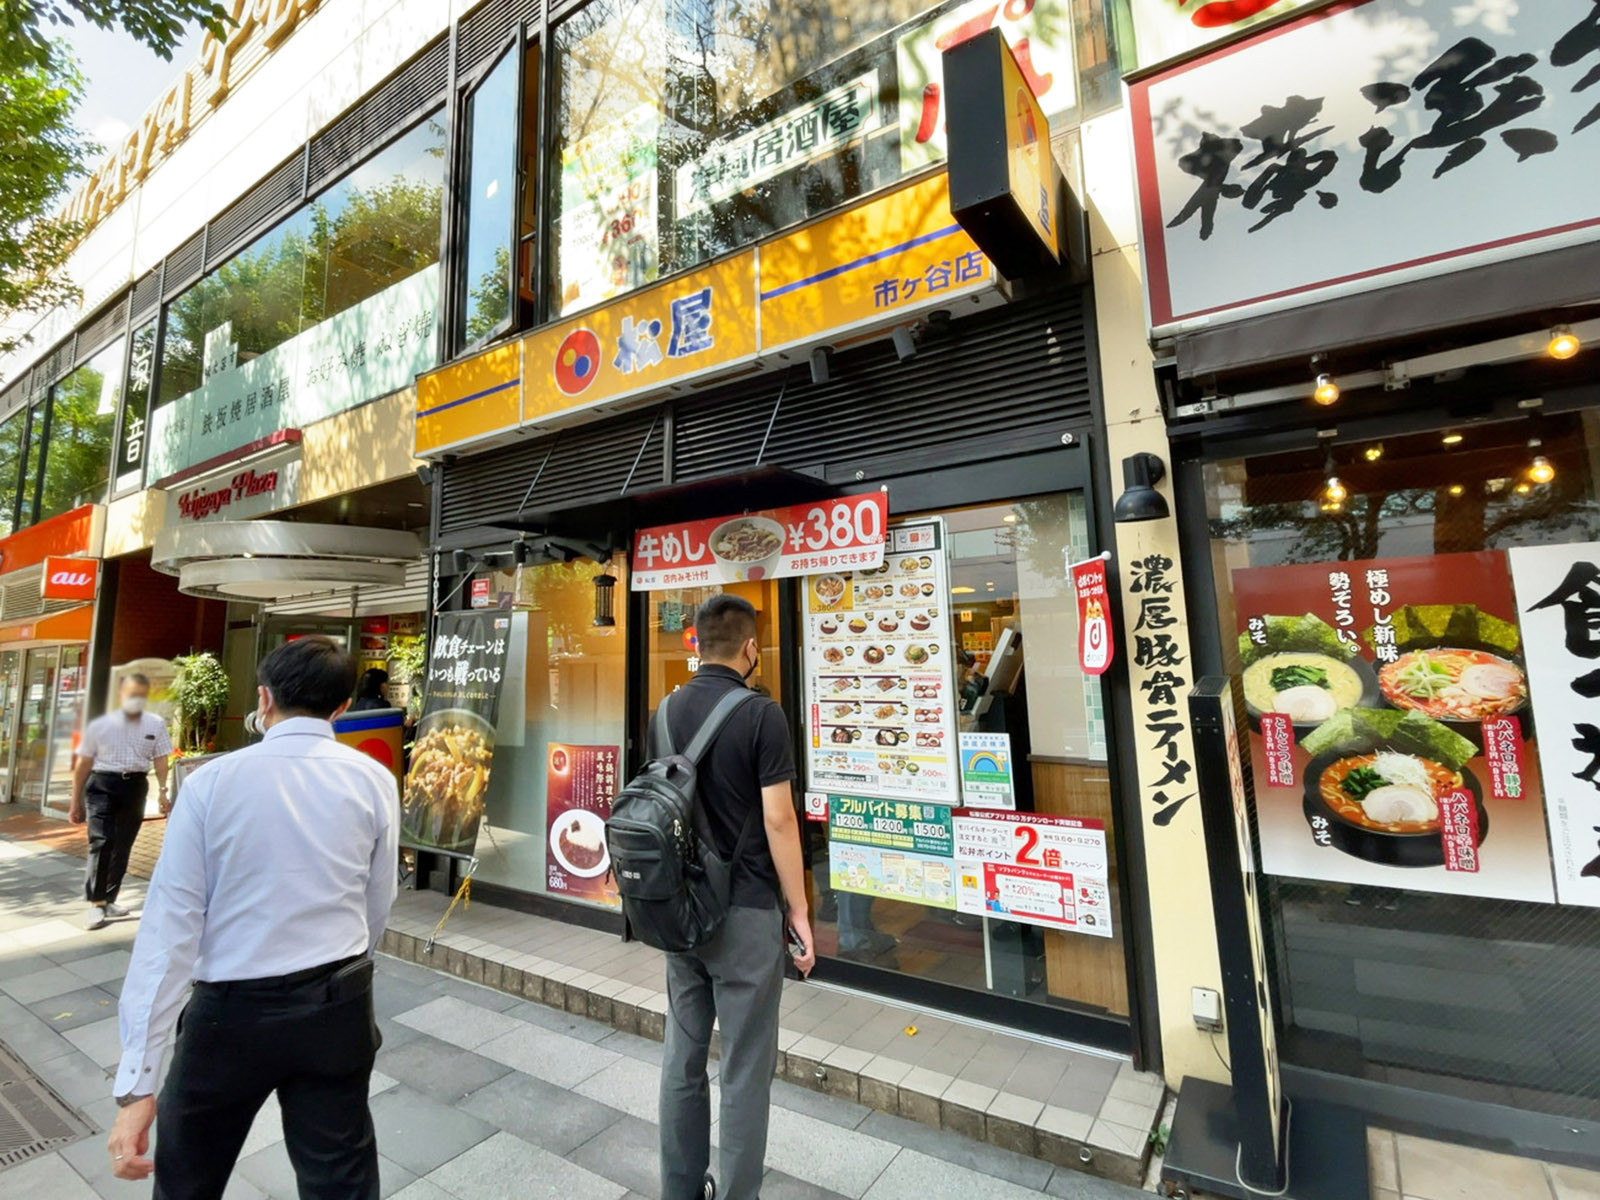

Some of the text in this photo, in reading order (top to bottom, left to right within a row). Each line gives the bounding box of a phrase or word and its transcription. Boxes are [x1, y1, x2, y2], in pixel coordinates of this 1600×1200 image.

[613, 288, 716, 376] 松屋
[231, 468, 278, 500] Plaza
[788, 499, 881, 552] ¥380
[637, 529, 706, 568] 牛めし
[791, 551, 878, 570] お持ち帰りできます
[51, 571, 92, 586] au
[662, 570, 709, 585] 店内みそ汁付
[1366, 569, 1399, 663] 極めし新味
[1248, 618, 1268, 645] みそ
[433, 634, 505, 660] 飲食チェーンは
[429, 660, 501, 687] いつも戦っている
[1129, 554, 1199, 827] 濃厚豚骨ラーメン
[1275, 716, 1294, 786] とんこつ味噌
[837, 815, 864, 828] 1200
[840, 798, 923, 821] アルバイト募集
[875, 819, 903, 832] 1200
[915, 824, 945, 837] 1500
[1311, 816, 1331, 845] みそ
